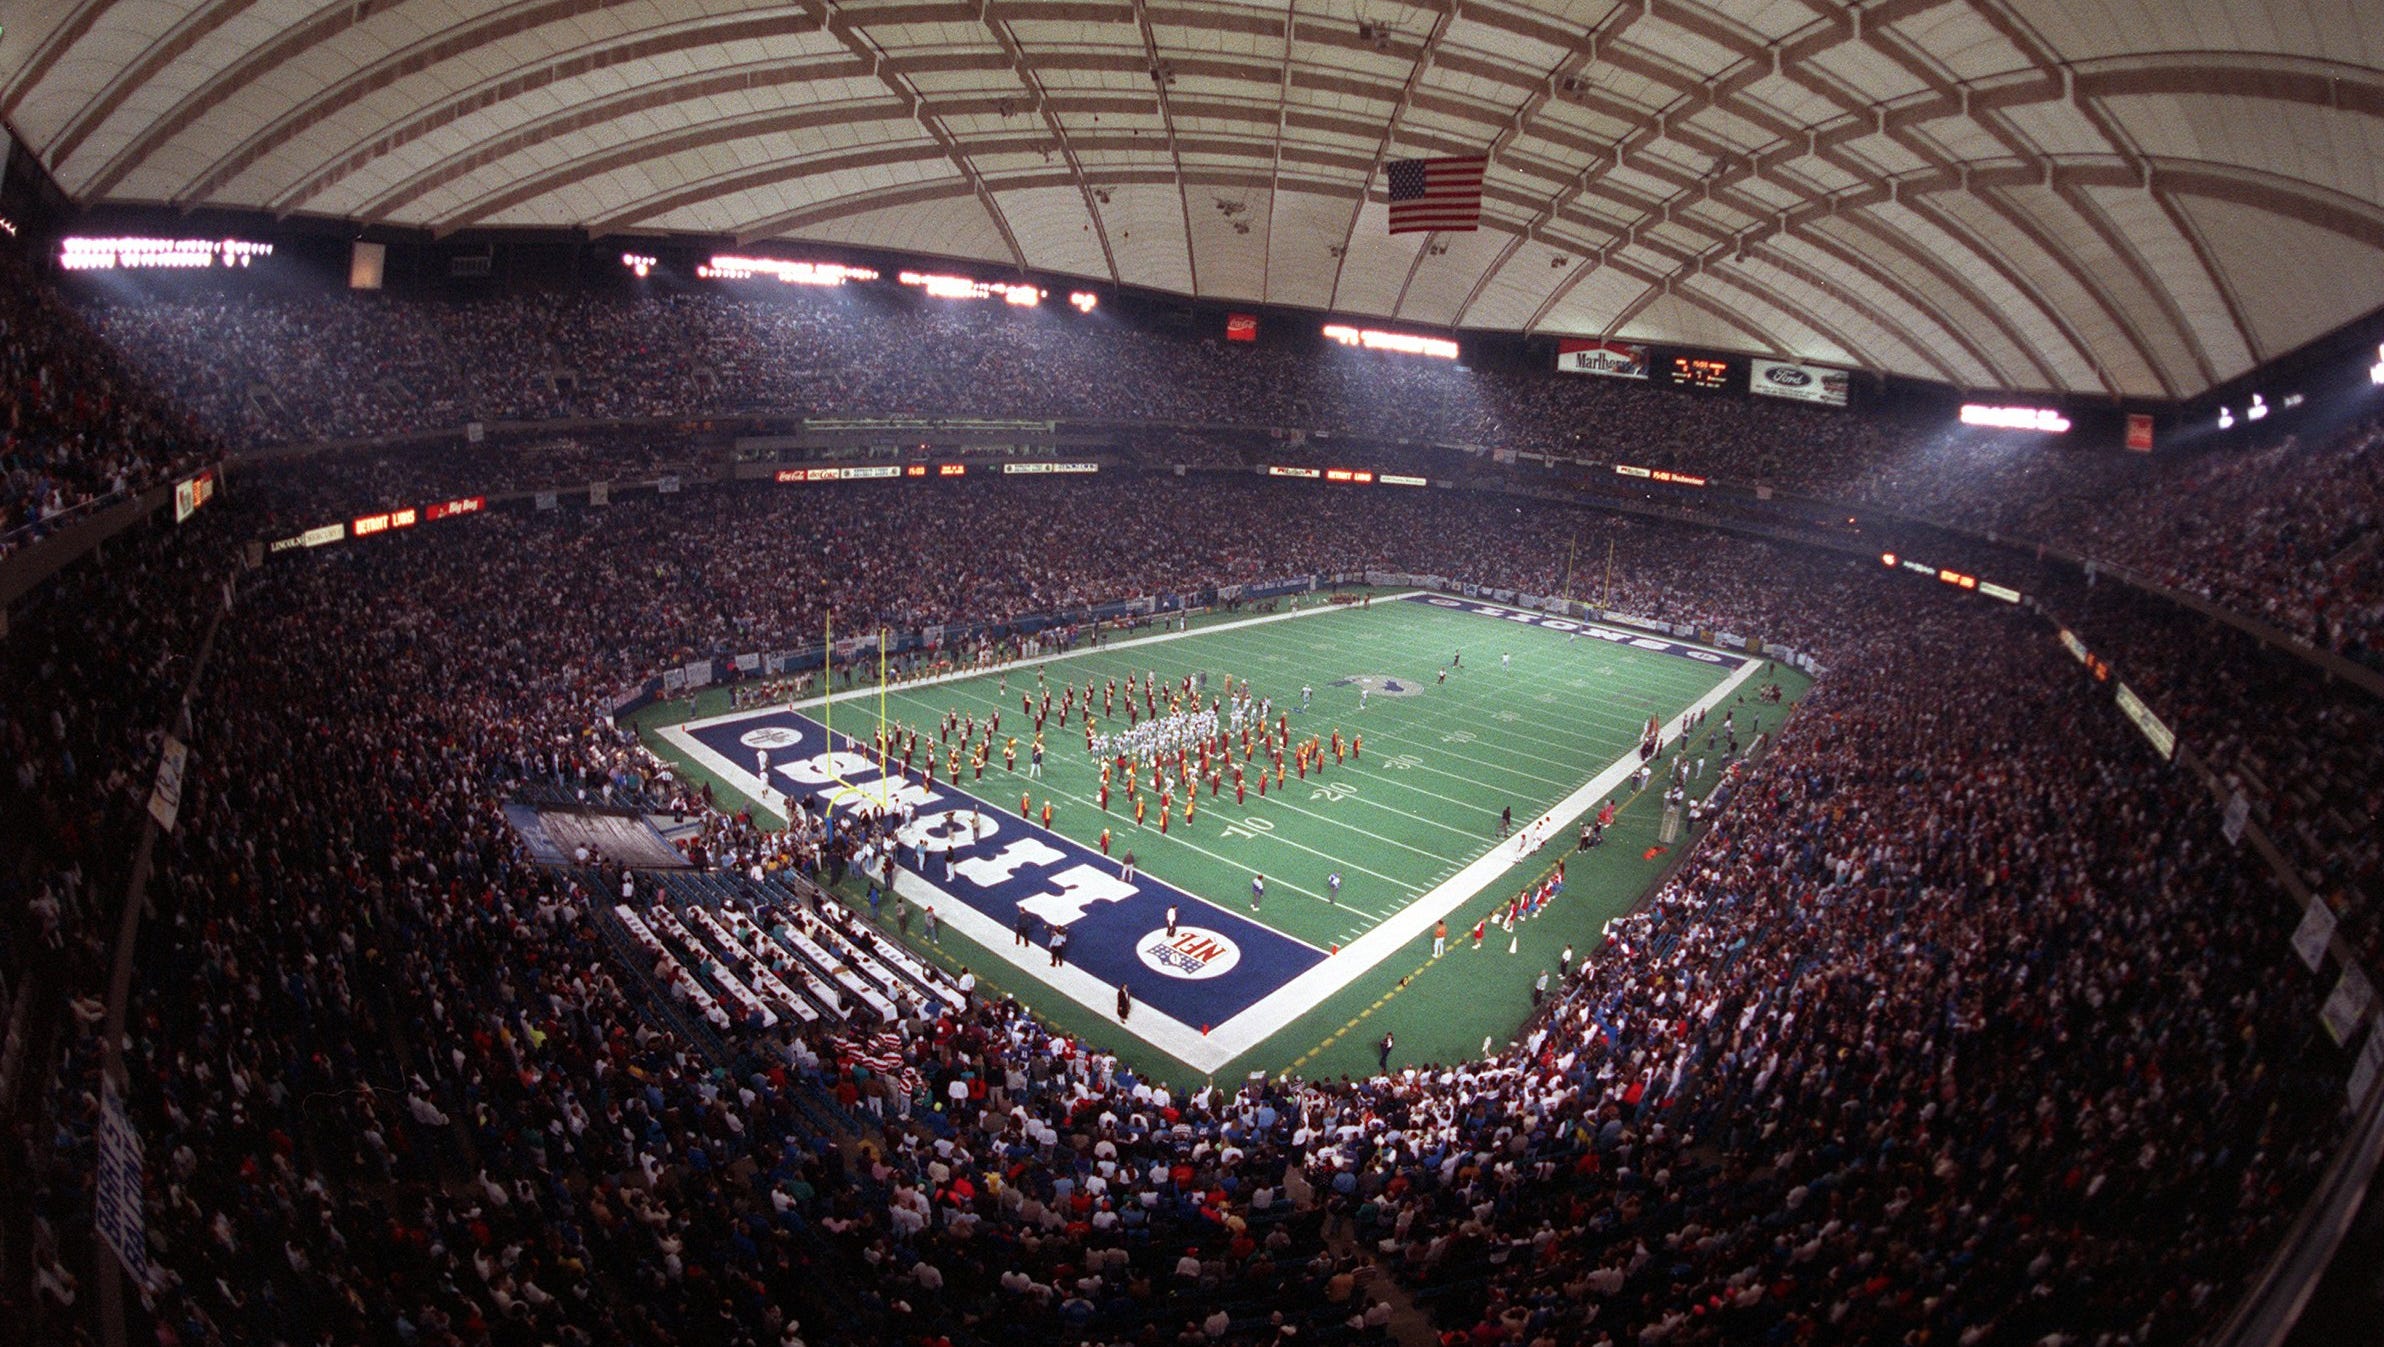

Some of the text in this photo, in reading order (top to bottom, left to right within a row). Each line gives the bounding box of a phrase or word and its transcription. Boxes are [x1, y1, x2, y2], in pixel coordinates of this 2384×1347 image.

[1575, 352, 1619, 371] Marlbor
[1773, 367, 1805, 384] Ford
[449, 498, 479, 514] Big Boy
[355, 509, 416, 534] DETROIT LIONS
[1472, 607, 1672, 651] LIONS
[1310, 782, 1358, 801] 20
[774, 751, 1140, 926] LIONS
[1220, 816, 1275, 840] 10
[1171, 932, 1228, 963] NFL
